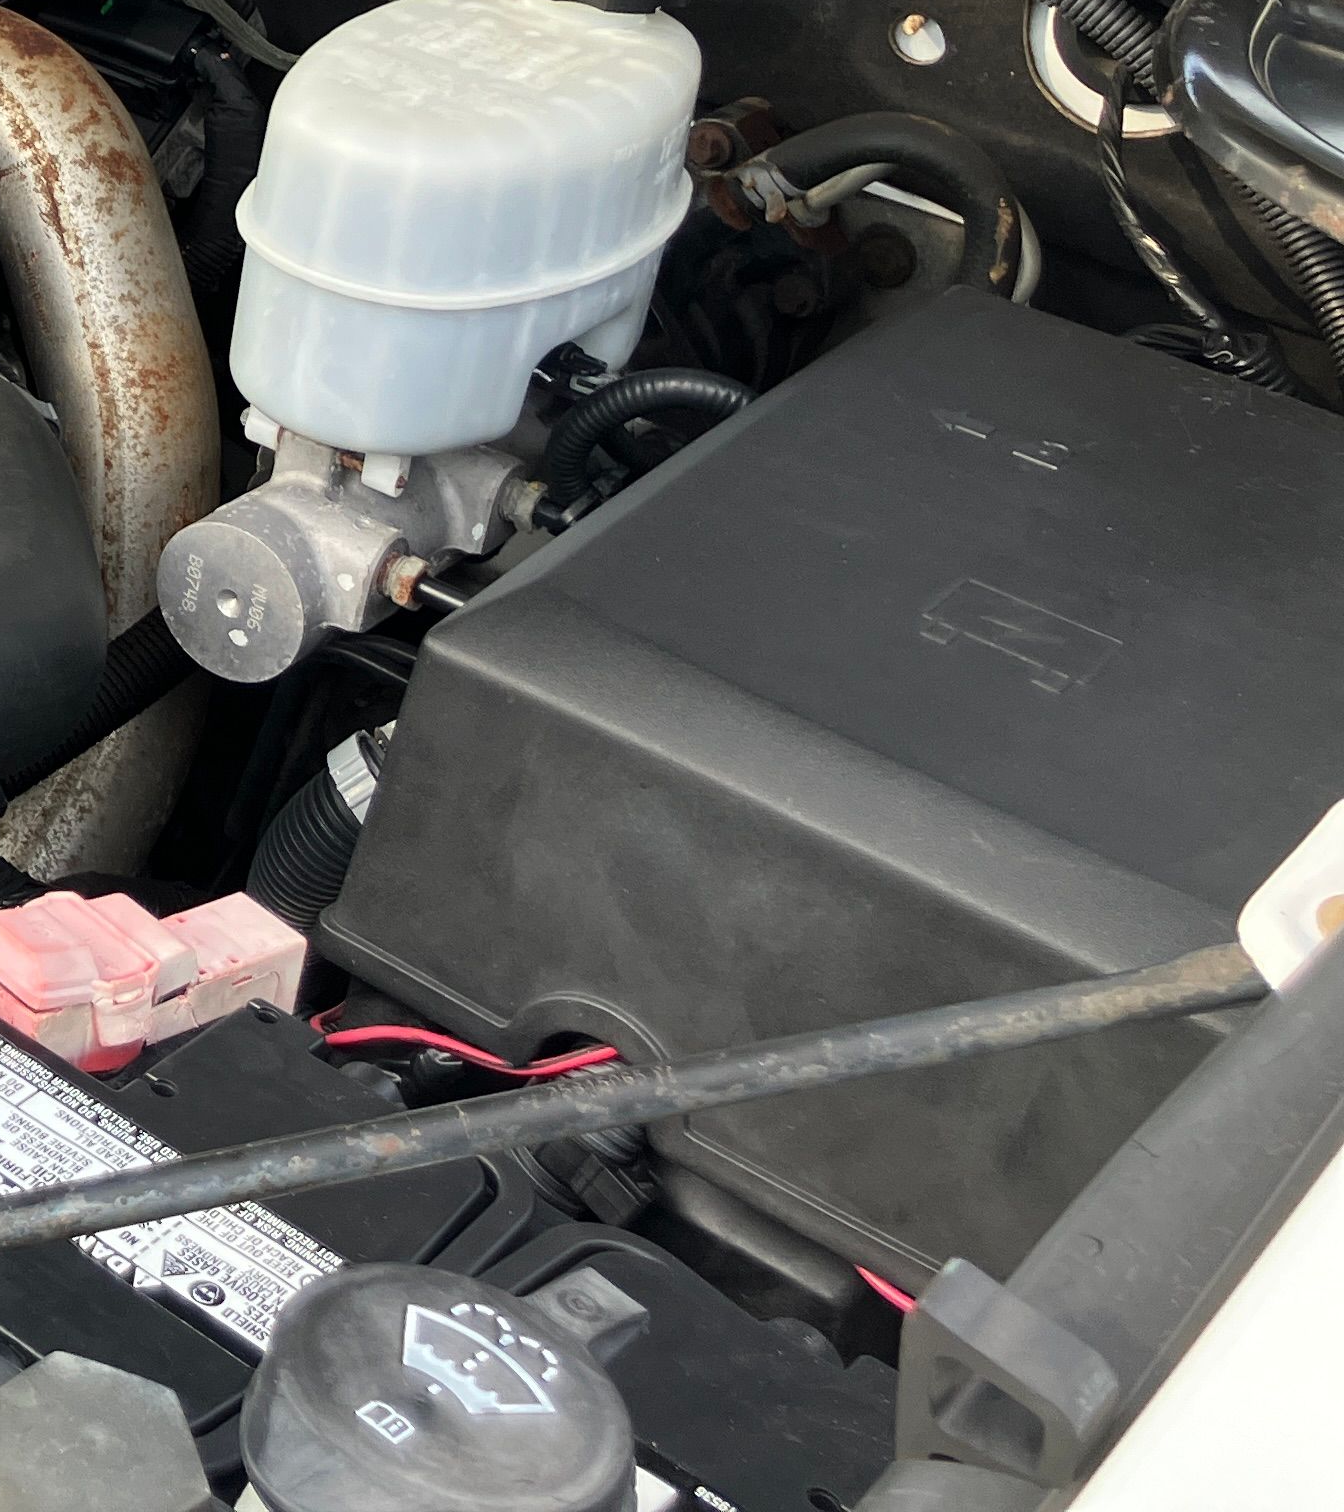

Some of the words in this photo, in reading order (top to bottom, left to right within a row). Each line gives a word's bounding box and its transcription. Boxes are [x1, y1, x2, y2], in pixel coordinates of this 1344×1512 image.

[4, 1077, 24, 1090] DO
[50, 1077, 94, 1104] PROPER
[55, 1092, 79, 1107] NOT
[76, 1104, 96, 1117] DO
[89, 1101, 137, 1131] FOLLOW
[0, 1120, 21, 1133] OR
[74, 1134, 97, 1148] ALL
[132, 1141, 152, 1154] OR
[10, 1138, 50, 1163] CAUSE
[20, 1132, 84, 1172] BLINDNESS
[46, 1137, 93, 1166] SEVERE
[94, 1146, 128, 1167] READ
[48, 1162, 75, 1179] CAN
[231, 1205, 253, 1219] OF
[194, 1213, 220, 1230] THE
[251, 1218, 282, 1237] RISK
[118, 1231, 139, 1244] NO
[217, 1228, 238, 1241] OF
[241, 1232, 262, 1245] OF
[173, 1234, 237, 1273] BLINDNESS
[236, 1240, 264, 1257] OUT
[260, 1244, 303, 1271] REACH
[315, 1246, 344, 1264] NOT
[176, 1247, 220, 1274] GASES
[261, 1256, 295, 1277] KEEP
[233, 1272, 274, 1297] CAUSE
[220, 1308, 269, 1339] SHIELD
